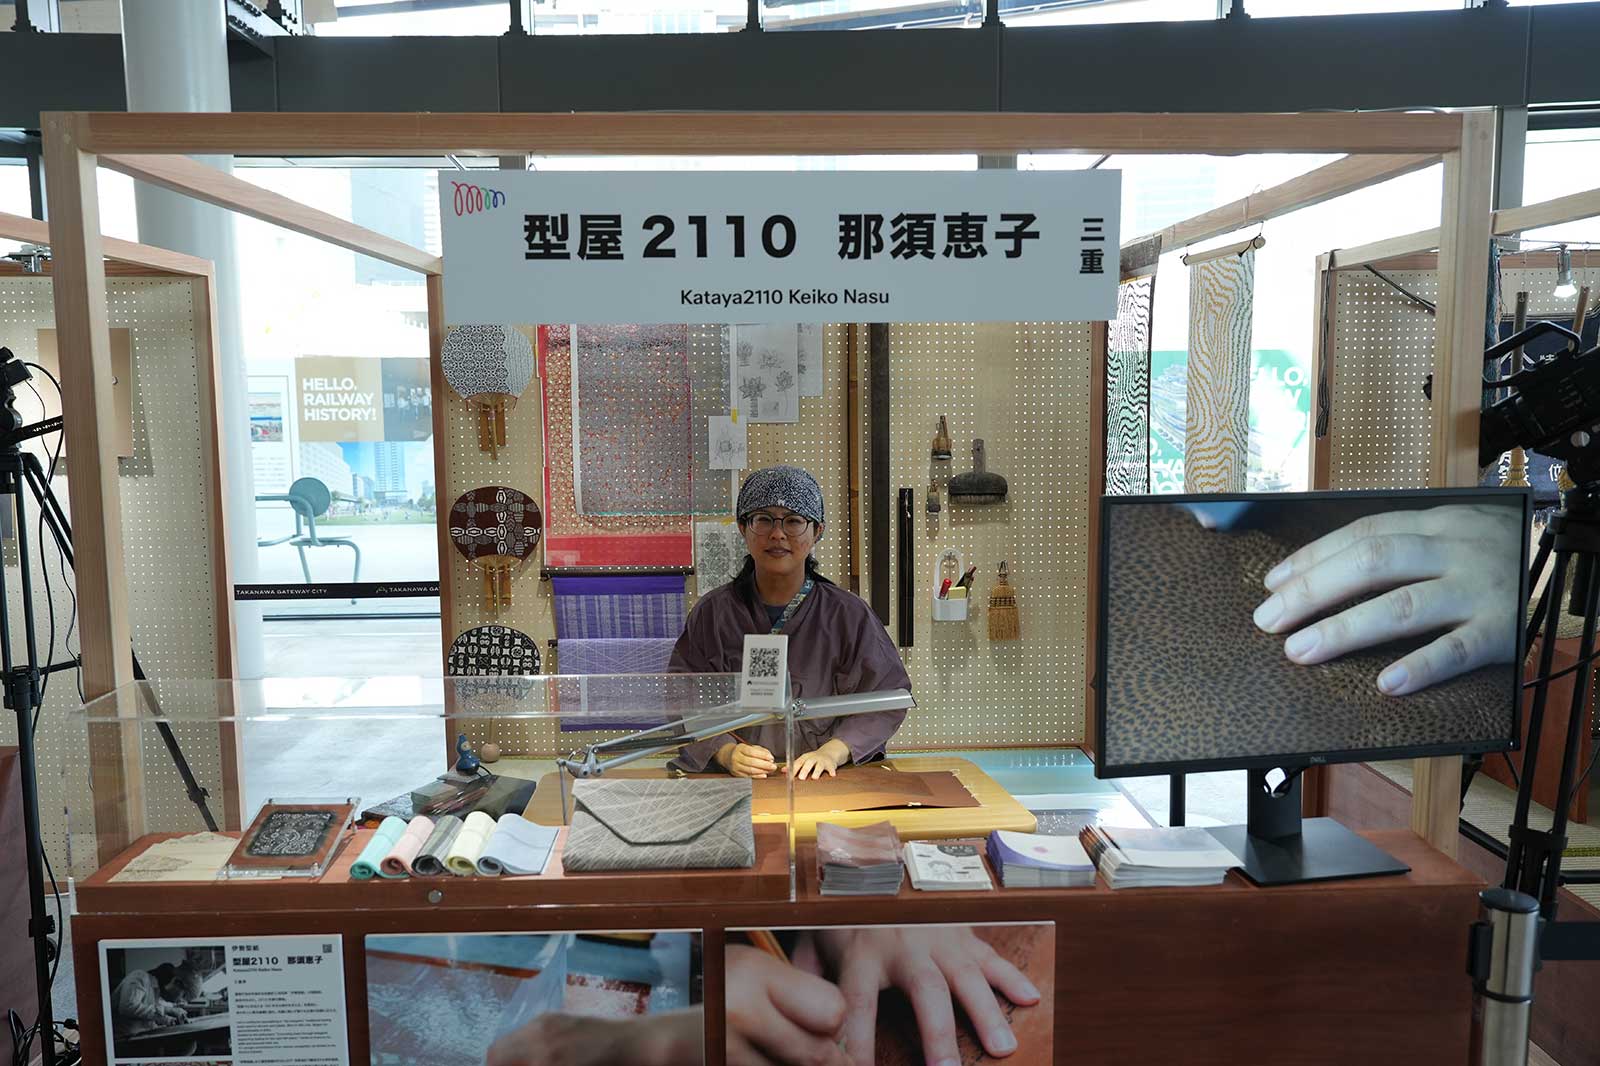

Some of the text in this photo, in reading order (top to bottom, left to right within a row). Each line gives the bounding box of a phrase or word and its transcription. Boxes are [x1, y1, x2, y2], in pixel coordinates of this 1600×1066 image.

[523, 212, 1041, 261] 型屋2110 那須恵子
[1079, 217, 1105, 275] 三重
[680, 289, 890, 308] Kataya2110 Keiko Nasu
[303, 392, 375, 406] RAILWAY
[304, 407, 377, 421] HISTORY!
